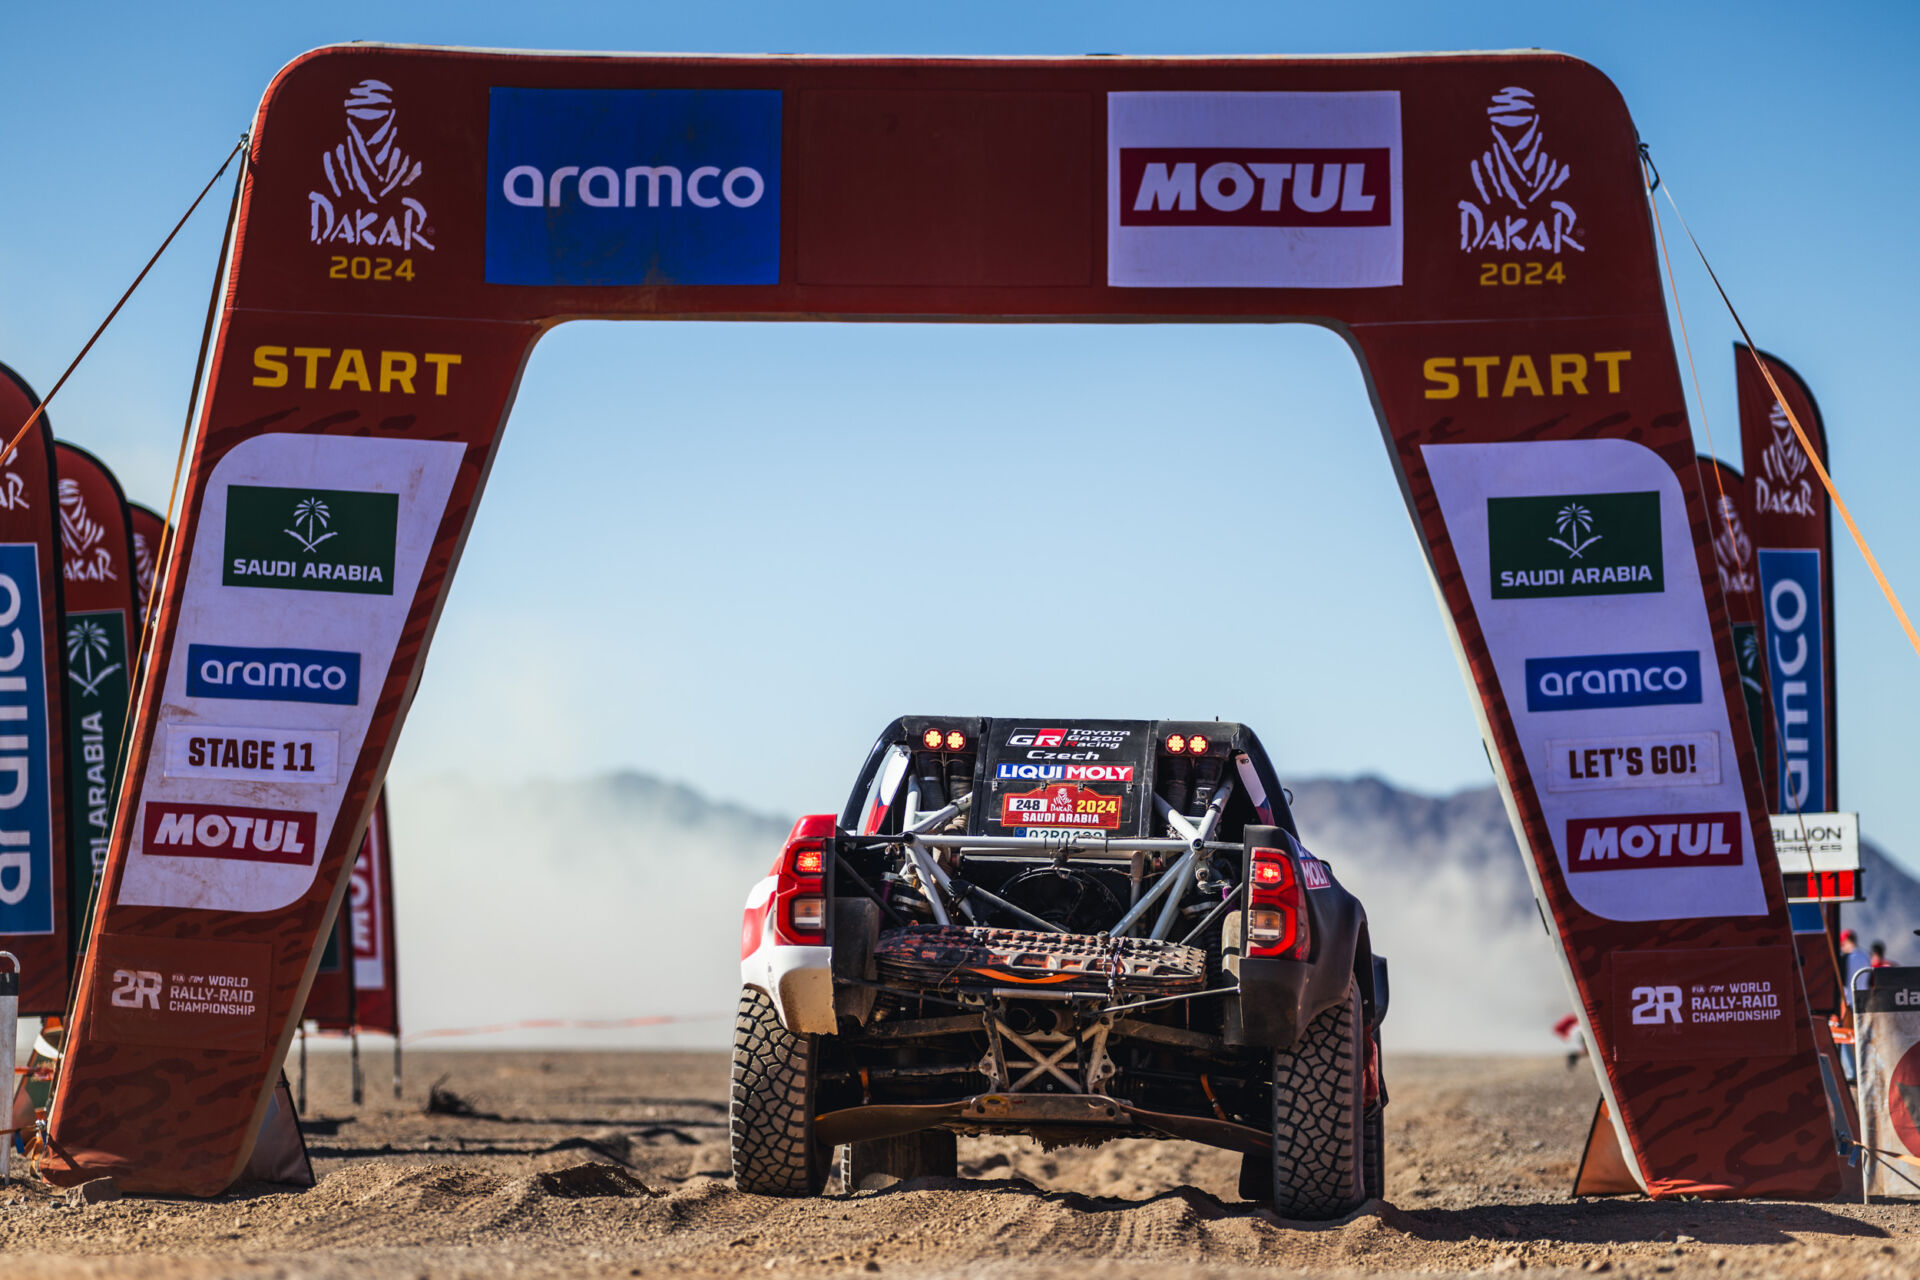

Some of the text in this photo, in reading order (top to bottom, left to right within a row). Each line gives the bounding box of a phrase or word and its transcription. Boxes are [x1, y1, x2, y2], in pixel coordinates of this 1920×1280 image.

[503, 165, 764, 208] aramco
[1133, 161, 1376, 213] MOTUL
[309, 190, 435, 251] DAKAR
[1458, 198, 1586, 254] DAKAR
[330, 256, 415, 282] 2024
[1480, 262, 1566, 285] 2024
[252, 346, 462, 395] START
[1423, 351, 1631, 399] START
[1756, 476, 1815, 517] DAKAR
[64, 548, 118, 583] AKAR
[233, 558, 383, 583] SAUDI ARABIA
[1500, 564, 1653, 587] SAUDI ARABIA
[201, 660, 347, 691] aramco
[1540, 666, 1687, 697] aramco
[1009, 728, 1131, 747] GR TOYOTA
[1064, 741, 1120, 749] Racing
[81, 711, 108, 829] ARABIA
[188, 737, 315, 772] STAGE 11
[1026, 750, 1100, 760] Czech
[1569, 744, 1697, 779] LET'S GO!
[1000, 765, 1133, 780] LIQUI MOLY
[1016, 799, 1040, 810] 248
[1022, 812, 1099, 824] SAUDI ARABIA
[1076, 800, 1117, 813] 2024
[153, 813, 305, 854] MOTUL
[1578, 822, 1731, 861] MOTUL
[112, 969, 162, 1010] 2R
[208, 975, 249, 988] WORLD
[170, 986, 254, 1003] RALLY-RAID
[1632, 985, 1683, 1025] 2R
[1729, 981, 1771, 994] WORLD
[1691, 994, 1778, 1010] RALLY-RAID
[169, 1000, 256, 1016] CHAMPIONSHIP
[1692, 1009, 1782, 1023] CHAMPIONSHIP
